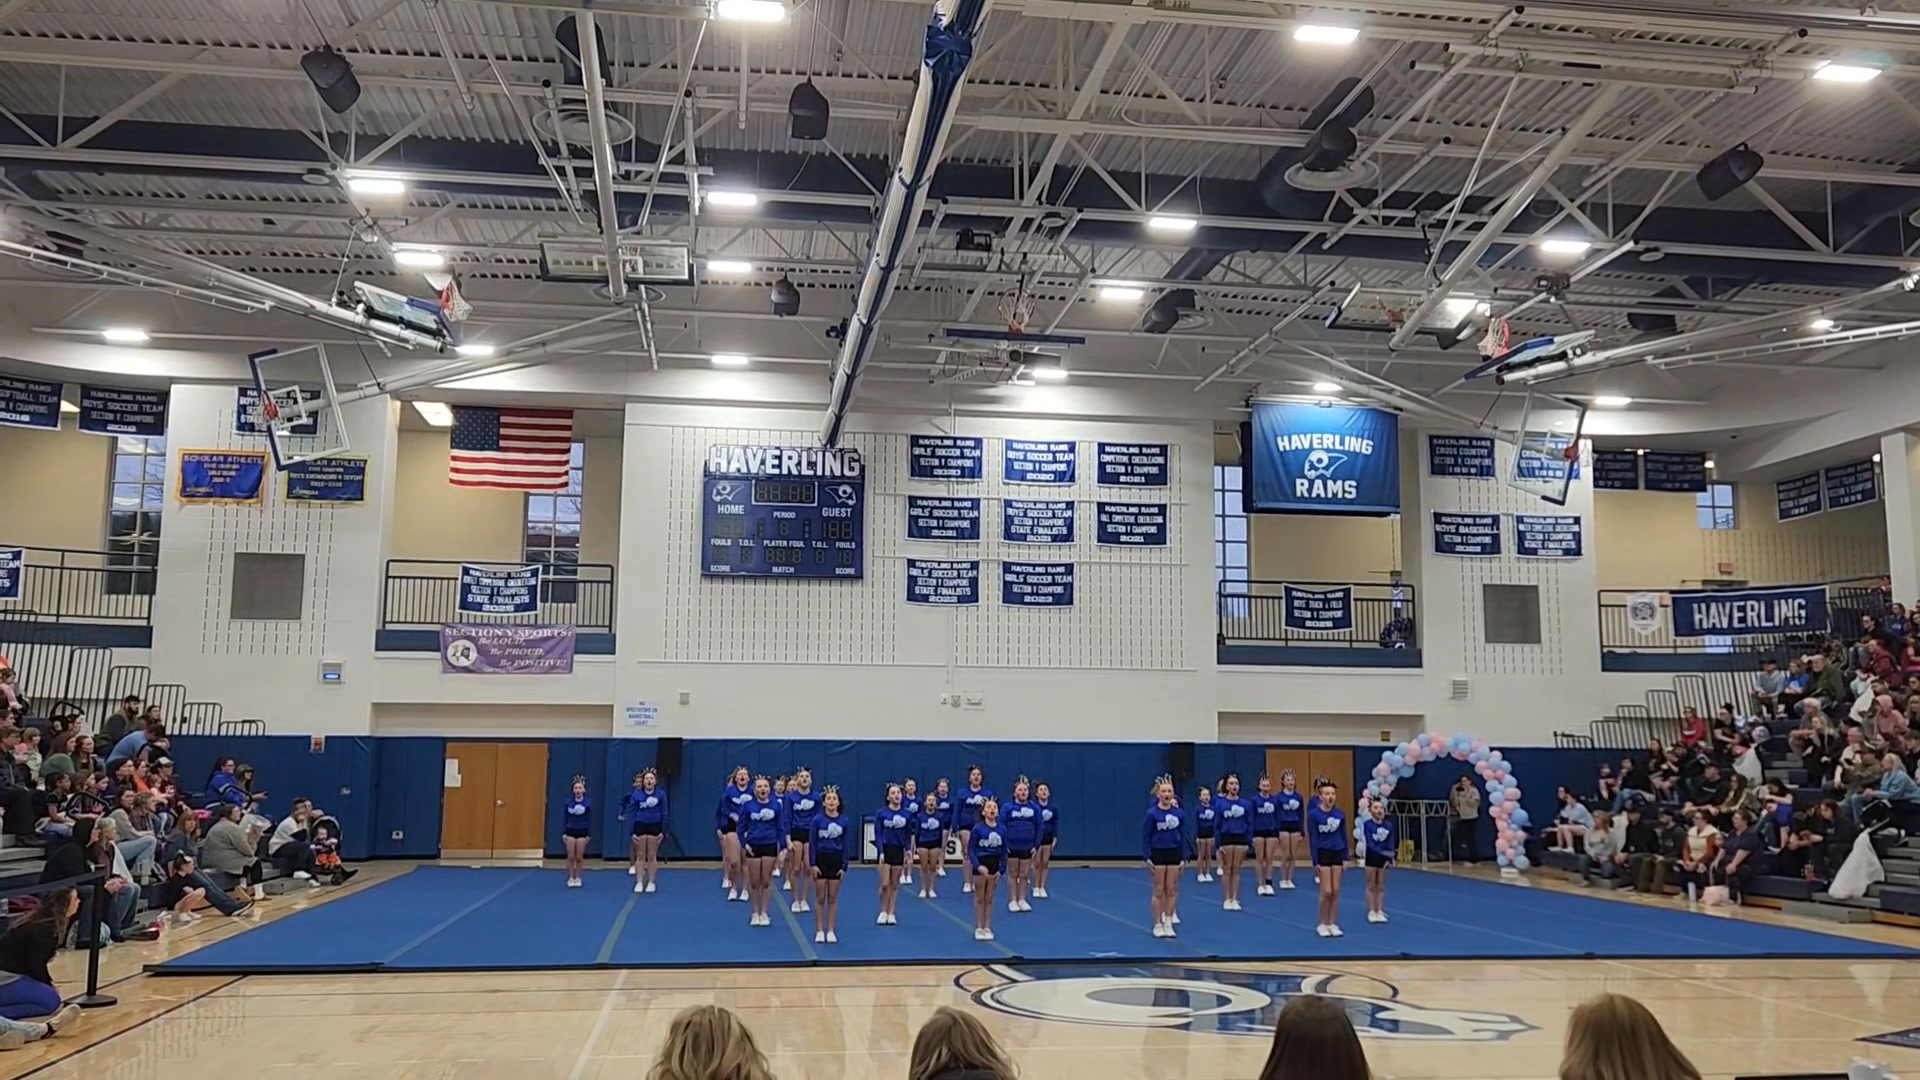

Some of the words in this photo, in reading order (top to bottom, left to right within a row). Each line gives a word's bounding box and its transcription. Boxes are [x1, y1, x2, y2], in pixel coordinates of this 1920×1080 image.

[38, 394, 58, 403] TEAM
[90, 391, 133, 401] HAVERLING
[136, 394, 158, 402] RAMS
[107, 402, 139, 412] SOCCER
[142, 404, 164, 412] TEAM
[90, 411, 114, 420] SECTION
[919, 438, 953, 446] HAVERLING
[1012, 442, 1048, 451] HAVERLING
[1276, 433, 1374, 455] HAVERLING
[935, 448, 960, 456] SOCCER
[962, 449, 980, 457] TEAM
[1026, 452, 1053, 461] SOCCER
[1055, 453, 1074, 461] TEAM
[227, 456, 263, 464] ATHLETE
[709, 445, 860, 477] HAVERLING
[920, 458, 939, 466] SECTION
[1013, 461, 1033, 470] SECTION
[1106, 465, 1125, 473] SECTION
[1295, 478, 1357, 499] RAMS
[717, 504, 745, 515] HOME
[1012, 501, 1046, 509] HAVERLING
[1105, 505, 1139, 513] HAVERLING
[773, 511, 796, 519] PERIOD
[822, 508, 852, 518] GUEST
[932, 509, 959, 517] SOCCER
[960, 510, 978, 518] TEAM
[1026, 509, 1053, 517] SOCCER
[918, 518, 937, 527] SECTION
[1013, 517, 1033, 525] SECTION
[1011, 525, 1032, 534] STATE
[1033, 526, 1068, 534] FINALISTS
[1106, 524, 1126, 532] SECTION
[1458, 525, 1500, 534] BASEBALL
[789, 540, 805, 548] FOUL
[836, 541, 856, 549] FOULS
[710, 564, 731, 572] SCORE
[772, 566, 794, 574] MATCH
[835, 567, 855, 575] SCORE
[1011, 565, 1046, 573] HAVERLING
[469, 569, 508, 578] HAVERLING
[931, 569, 958, 577] SOCCER
[917, 578, 937, 586] SECTION
[1026, 575, 1052, 583] SOCCER
[1054, 575, 1072, 583] TEAM
[470, 585, 491, 595] SECTION
[500, 587, 528, 595] CHAMPIONS
[915, 586, 935, 594] STATE
[937, 587, 971, 595] FINALISTS
[1012, 584, 1032, 593] SECTION
[467, 594, 490, 603] STATE
[492, 595, 530, 604] FINALISTS
[1292, 590, 1325, 599] HAVERLING
[1330, 600, 1342, 608] FIELD
[1692, 598, 1806, 630] HAVERLING
[445, 628, 505, 637] SECTION
[505, 629, 514, 637] V
[493, 637, 526, 646] LOUD,
[513, 659, 566, 667] POSITIVE!
